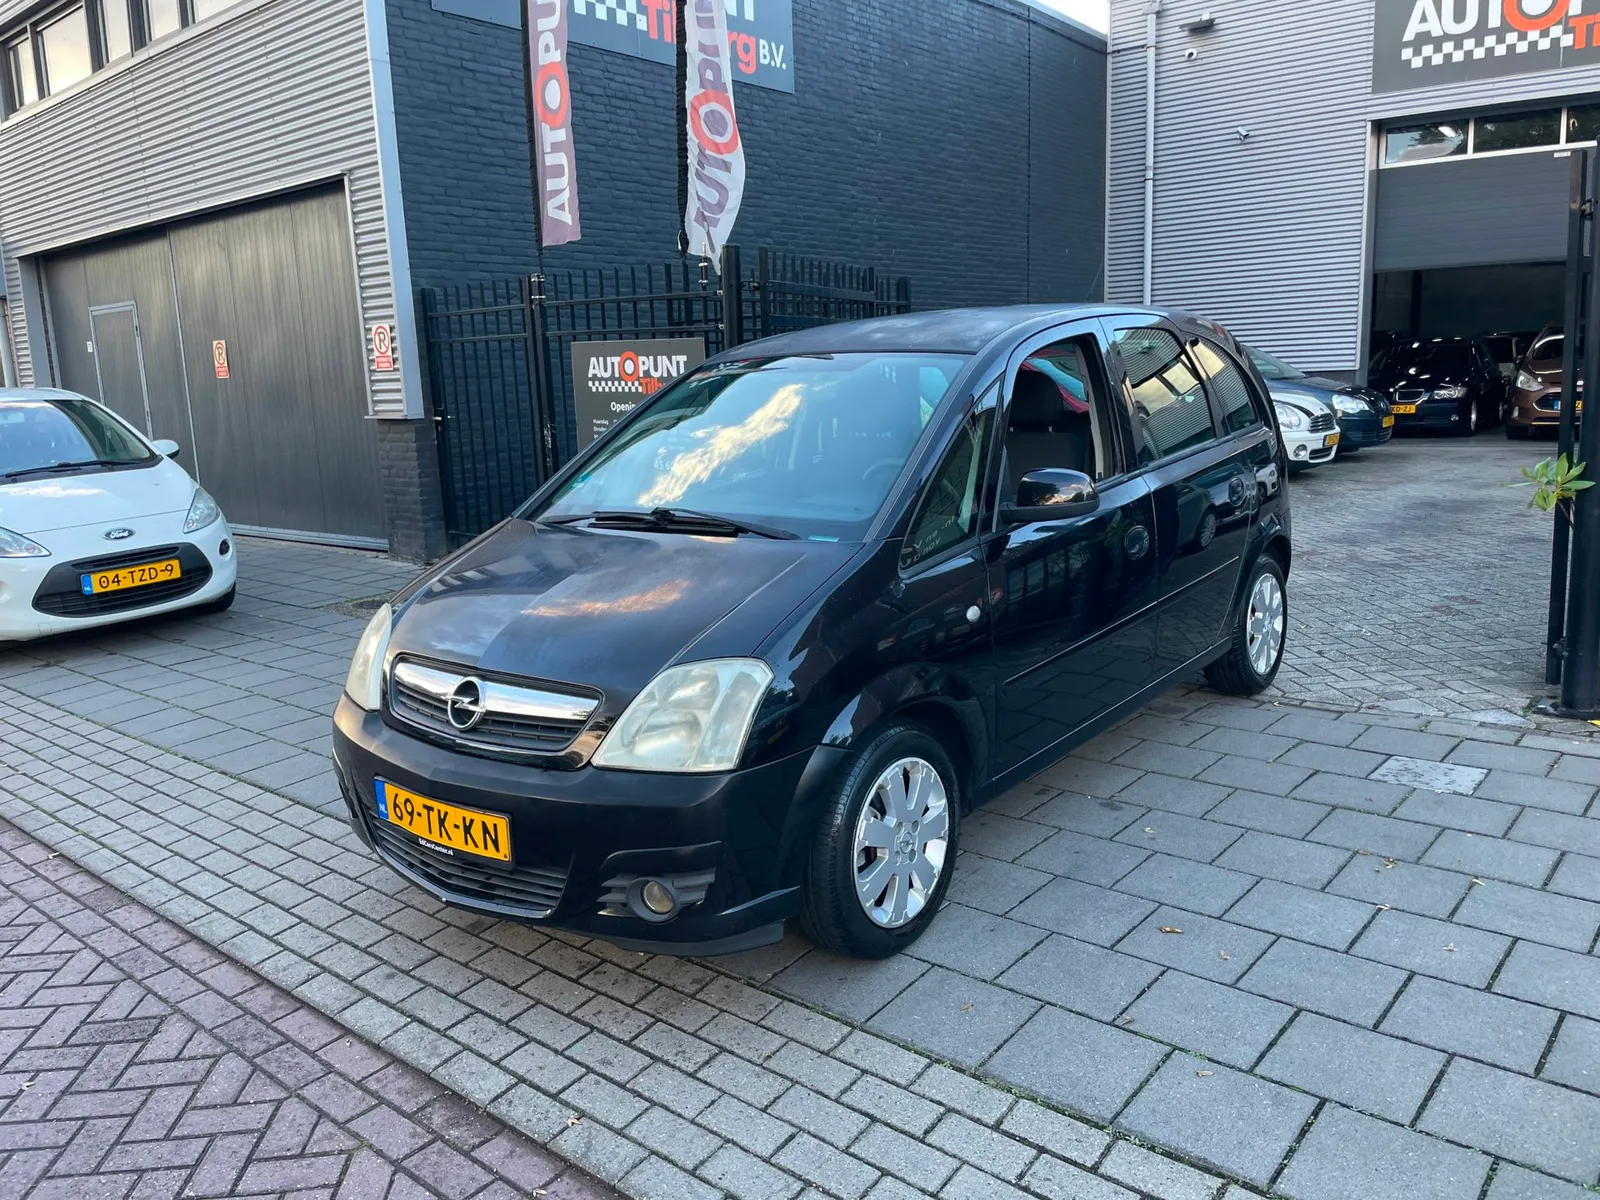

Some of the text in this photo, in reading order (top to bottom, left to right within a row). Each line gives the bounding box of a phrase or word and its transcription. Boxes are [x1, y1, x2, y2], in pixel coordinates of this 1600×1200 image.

[759, 38, 787, 70] B.V.
[588, 351, 687, 382] AUTOPUNT
[98, 563, 174, 589] 04-TZD-9
[379, 803, 388, 814] NL
[392, 793, 501, 853] 69-TK-KN
